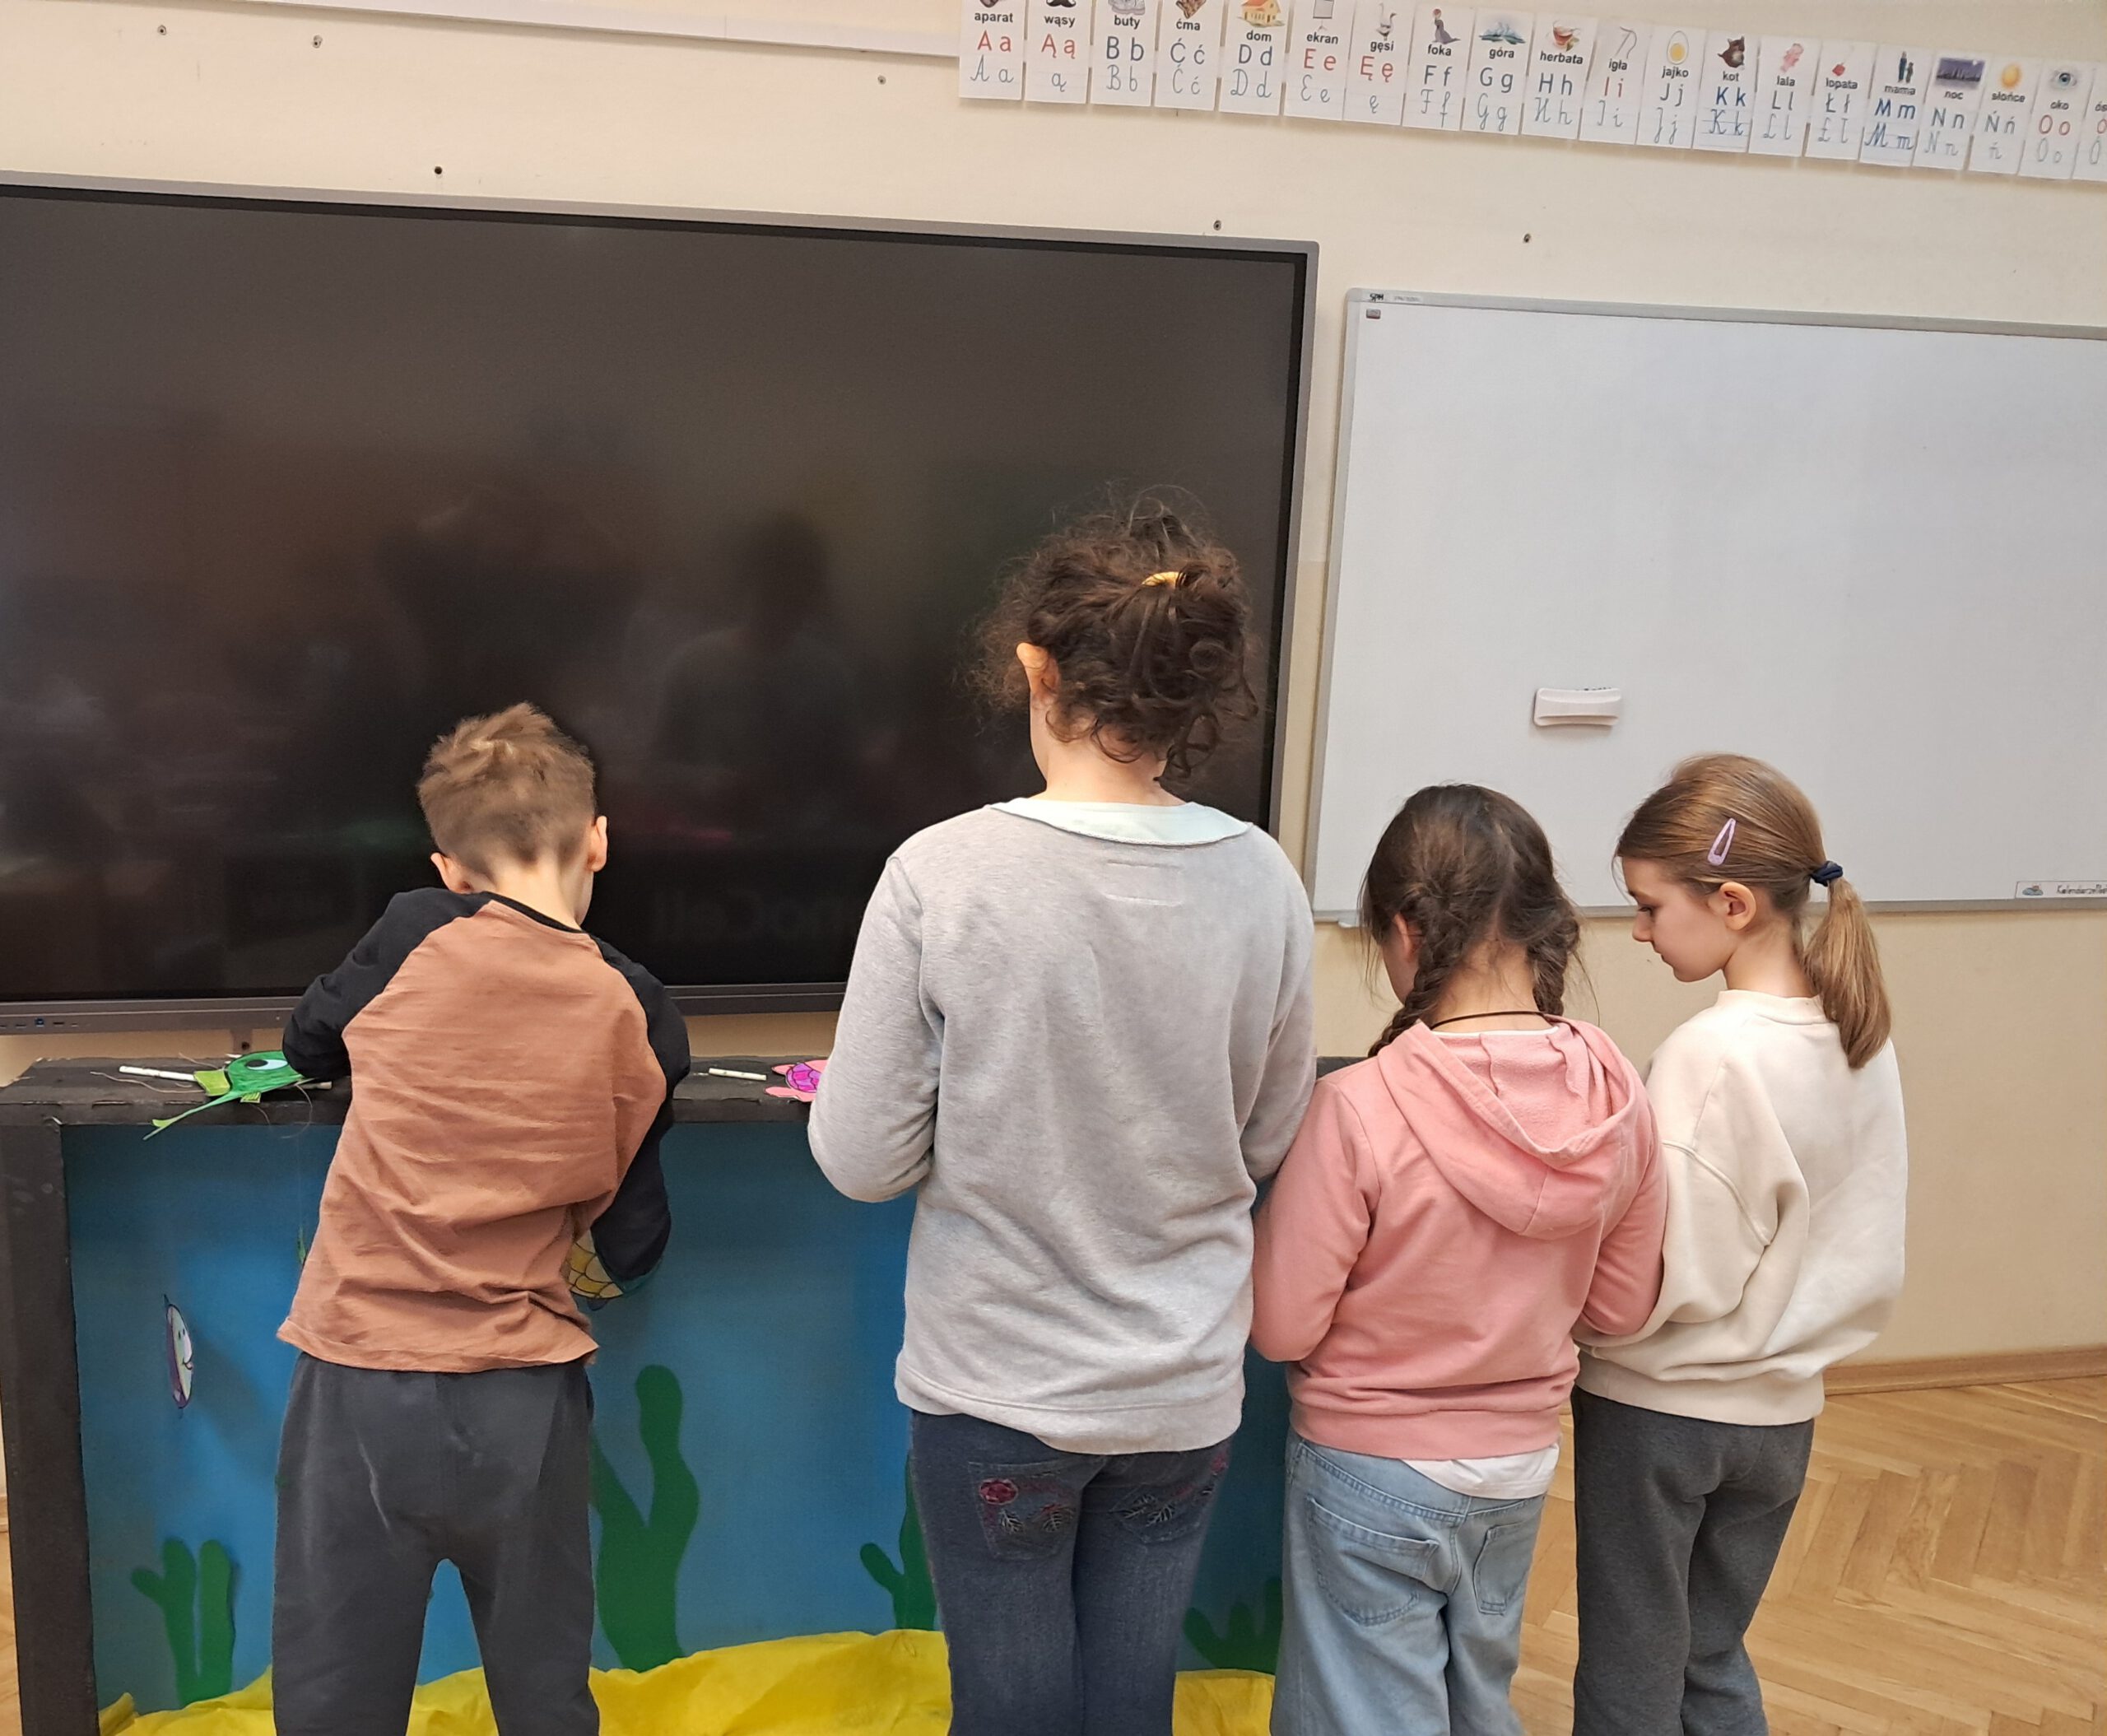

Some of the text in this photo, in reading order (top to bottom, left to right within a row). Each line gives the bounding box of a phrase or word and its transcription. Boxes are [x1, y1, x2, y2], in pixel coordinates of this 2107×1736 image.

[974, 12, 1013, 24] aparat
[1044, 15, 1076, 27] wąsy
[1114, 15, 1141, 29] buty
[1176, 19, 1201, 30] ćma
[977, 30, 1012, 52] A a
[1246, 30, 1272, 42] dom
[1306, 33, 1338, 44] ekran
[1042, 34, 1076, 59] Ą ą
[1106, 36, 1144, 61] B b
[1170, 39, 1205, 64] Ć ć
[1239, 44, 1272, 66] D d
[1370, 40, 1394, 53] gęsi
[1428, 44, 1452, 56] foka
[1489, 48, 1514, 59] góra
[1304, 49, 1337, 71] E e
[1540, 51, 1584, 64] herbata
[1609, 58, 1627, 72] igła
[1360, 56, 1394, 82] Ę ę
[1424, 65, 1453, 86] F f
[1662, 67, 1689, 79] jajko
[1723, 71, 1739, 82] kot
[1480, 67, 1514, 93] G g
[1539, 72, 1573, 95] H h
[1604, 77, 1624, 98] I i
[1777, 76, 1795, 87] lala
[1660, 84, 1684, 107] J j
[1716, 86, 1746, 107] K k
[1885, 85, 1916, 95] mama
[1944, 91, 1963, 100] noc
[1773, 91, 1793, 110] L l
[1826, 93, 1850, 113] Ł ł
[1874, 98, 1915, 119] M m
[2050, 100, 2069, 111] oko
[1932, 108, 1965, 129] N n
[1984, 110, 2016, 134] Ń ń
[2039, 115, 2071, 135] O o
